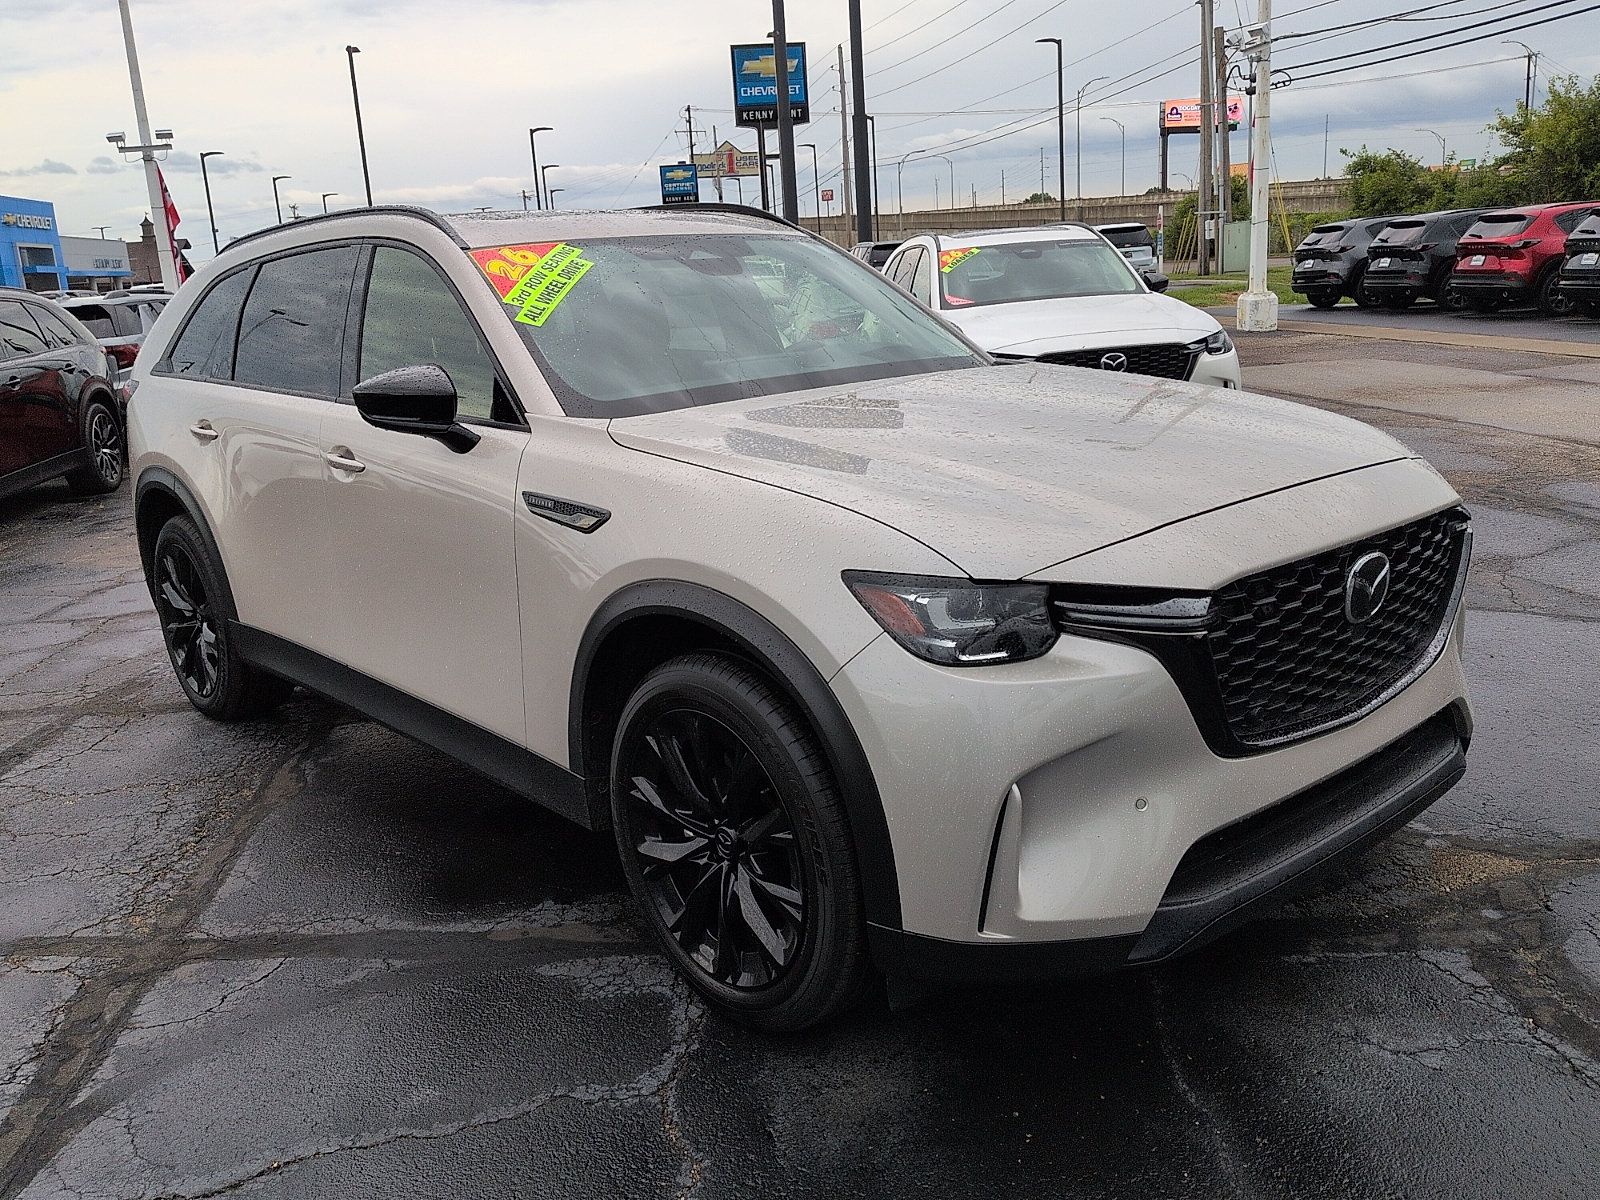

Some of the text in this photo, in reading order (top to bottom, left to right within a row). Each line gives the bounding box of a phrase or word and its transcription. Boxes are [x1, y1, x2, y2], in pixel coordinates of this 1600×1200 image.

[740, 85, 800, 97] CHEVRET
[742, 109, 774, 120] KENNY
[16, 214, 52, 230] CHEVROLET
[486, 249, 541, 281] 26
[947, 251, 975, 268] LOADED
[511, 246, 575, 305] 3rd ROW SEATING
[523, 259, 585, 322] ALL WHEEL DRIVE
